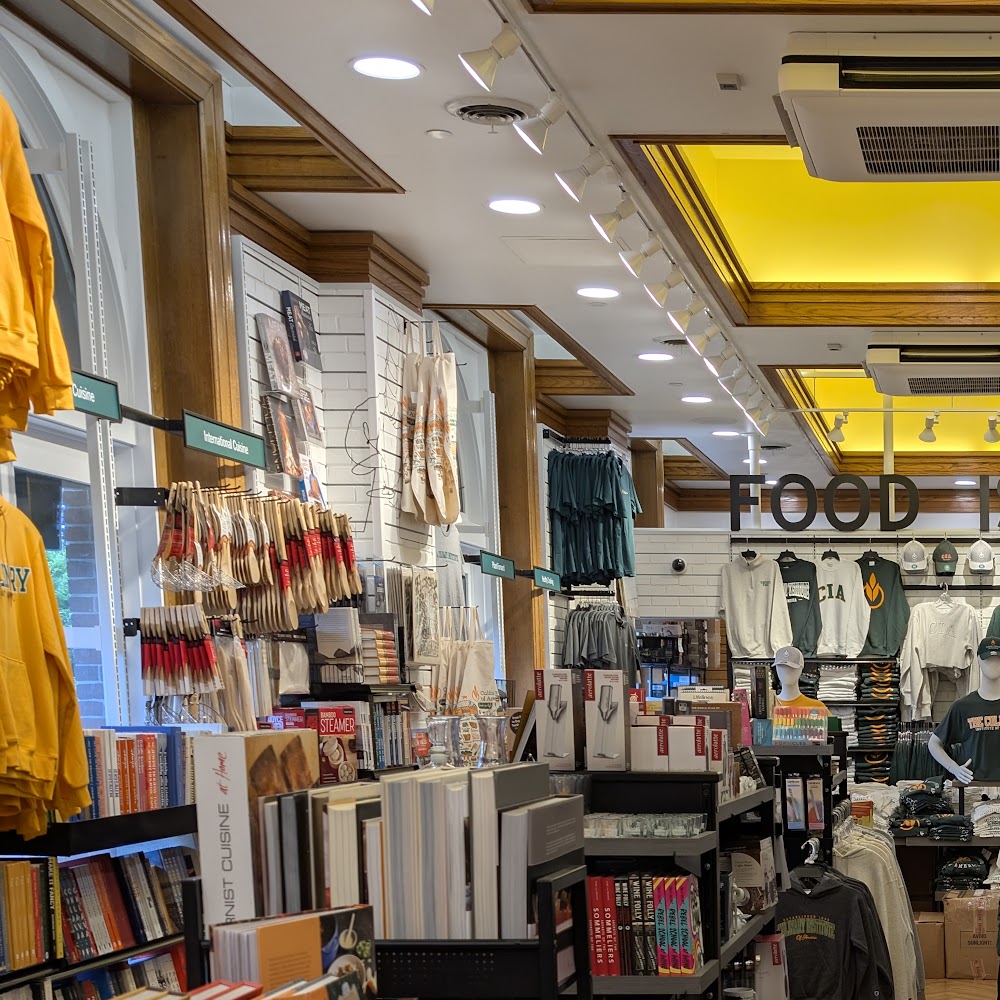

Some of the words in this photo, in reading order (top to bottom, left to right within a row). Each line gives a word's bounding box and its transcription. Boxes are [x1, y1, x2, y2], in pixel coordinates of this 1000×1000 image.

[72, 384, 95, 403] Cuisine
[203, 430, 232, 449] International
[232, 440, 249, 455] Cuisine
[729, 474, 919, 532] FOOD
[818, 584, 846, 603] CIA
[929, 622, 956, 638] CIA
[320, 718, 355, 733] STEAMER
[967, 716, 984, 730] THE
[215, 752, 232, 780] Home
[218, 780, 228, 795] at
[218, 803, 233, 872] CUISINE
[634, 901, 642, 920] FOLLY
[647, 901, 655, 920] FOLLY
[593, 908, 603, 964] SOMMELIERS
[605, 908, 614, 964] SOMMELIERS
